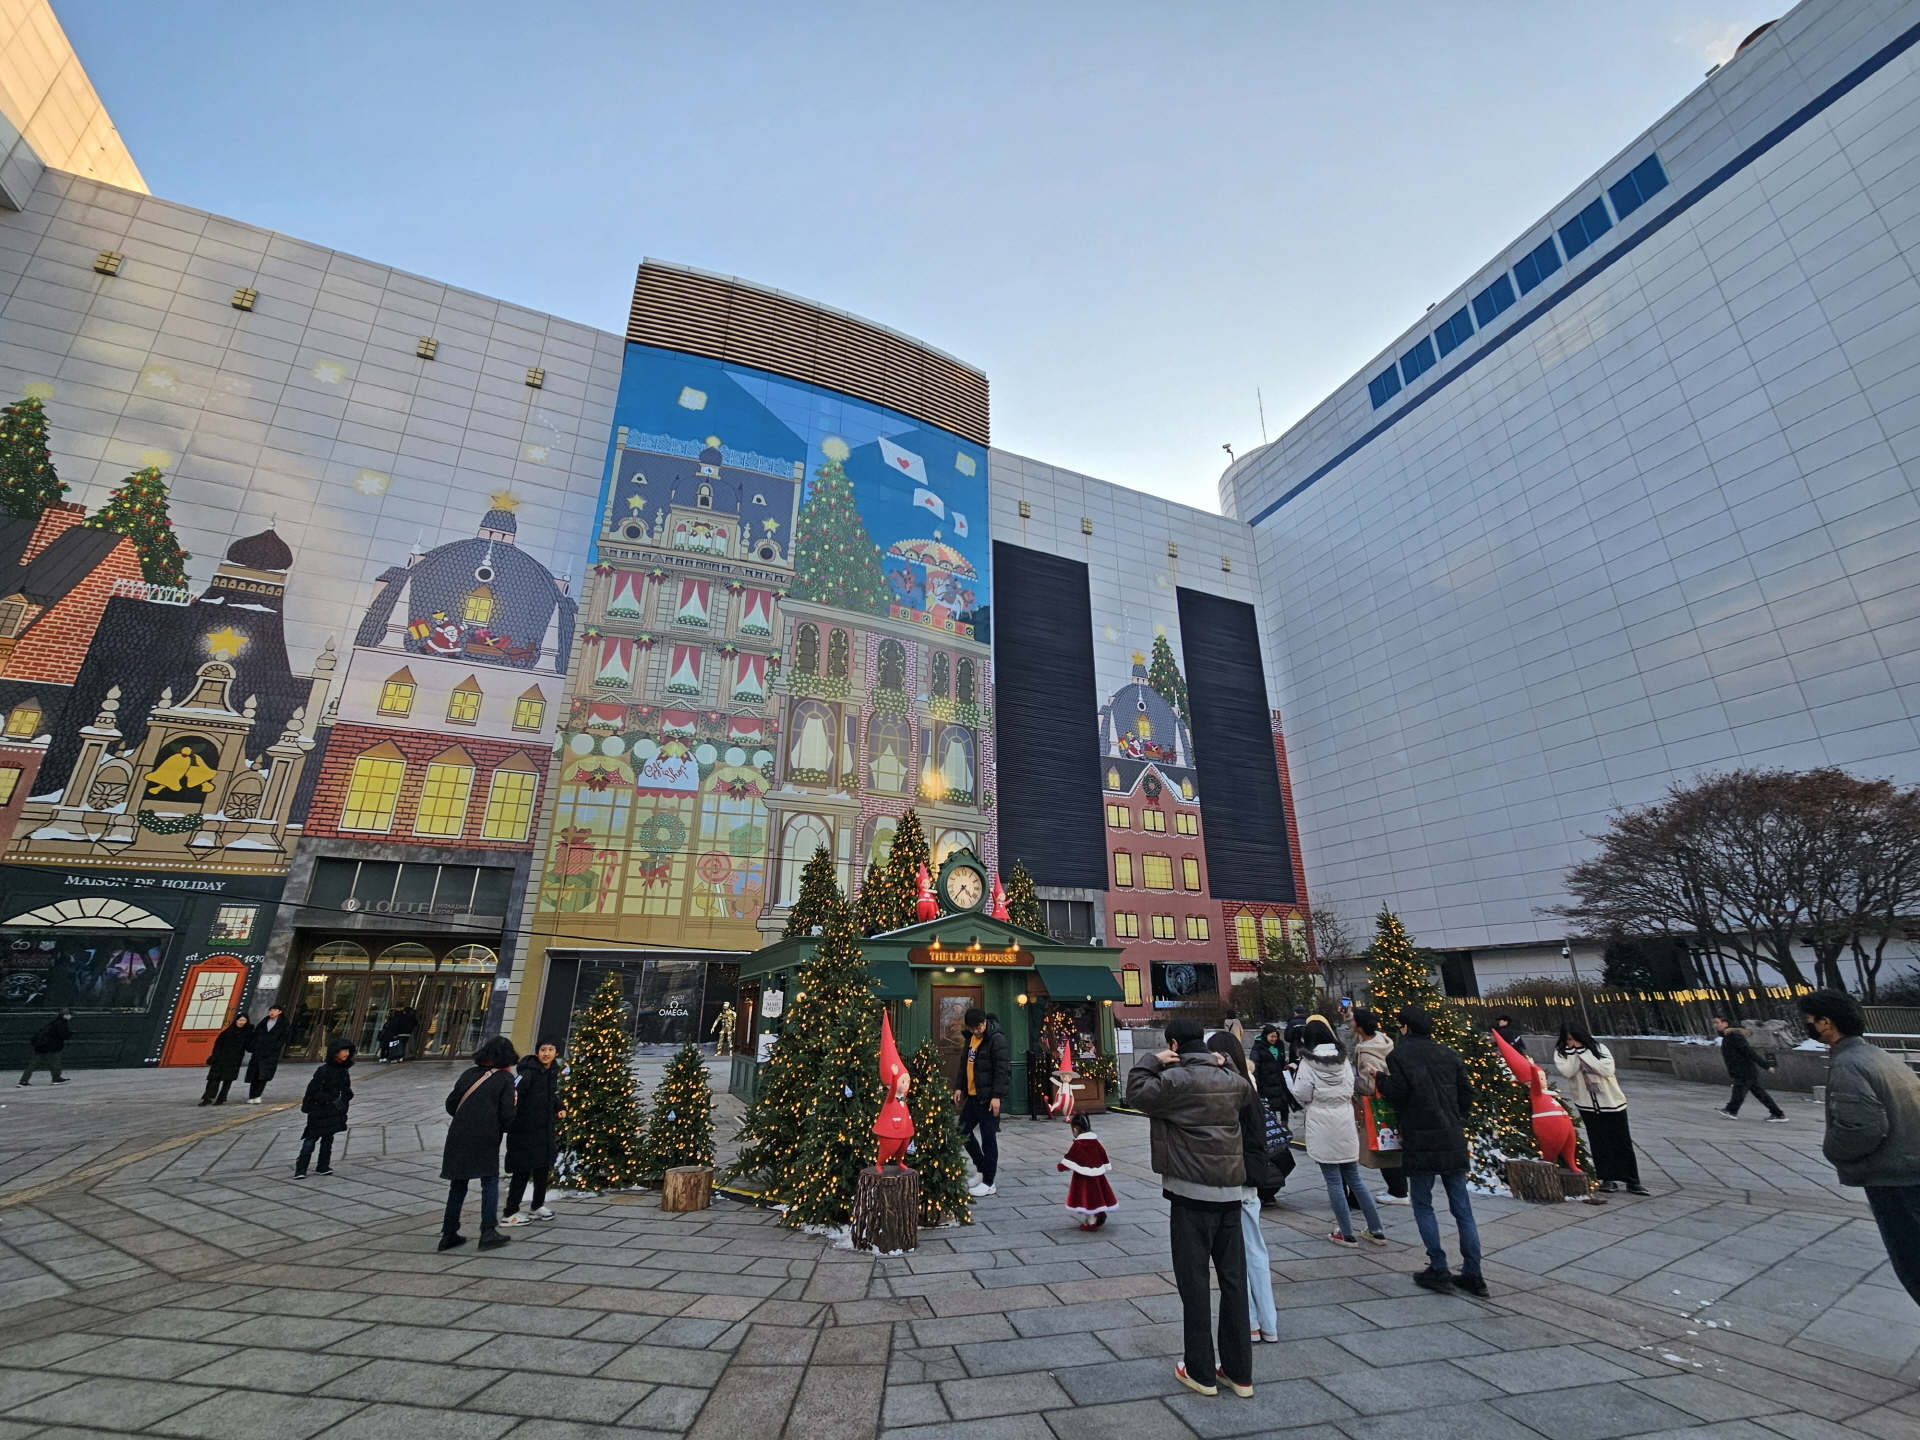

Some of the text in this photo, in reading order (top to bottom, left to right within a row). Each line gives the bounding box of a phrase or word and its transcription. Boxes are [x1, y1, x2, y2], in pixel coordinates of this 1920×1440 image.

[644, 760, 689, 783] Gift Shop
[64, 875, 129, 887] MAISON
[161, 879, 226, 891] HOLIDAY
[363, 900, 430, 914] LOTTE
[929, 951, 1017, 963] THE LETTER HOUSE
[658, 1008, 689, 1017] OMEGA
